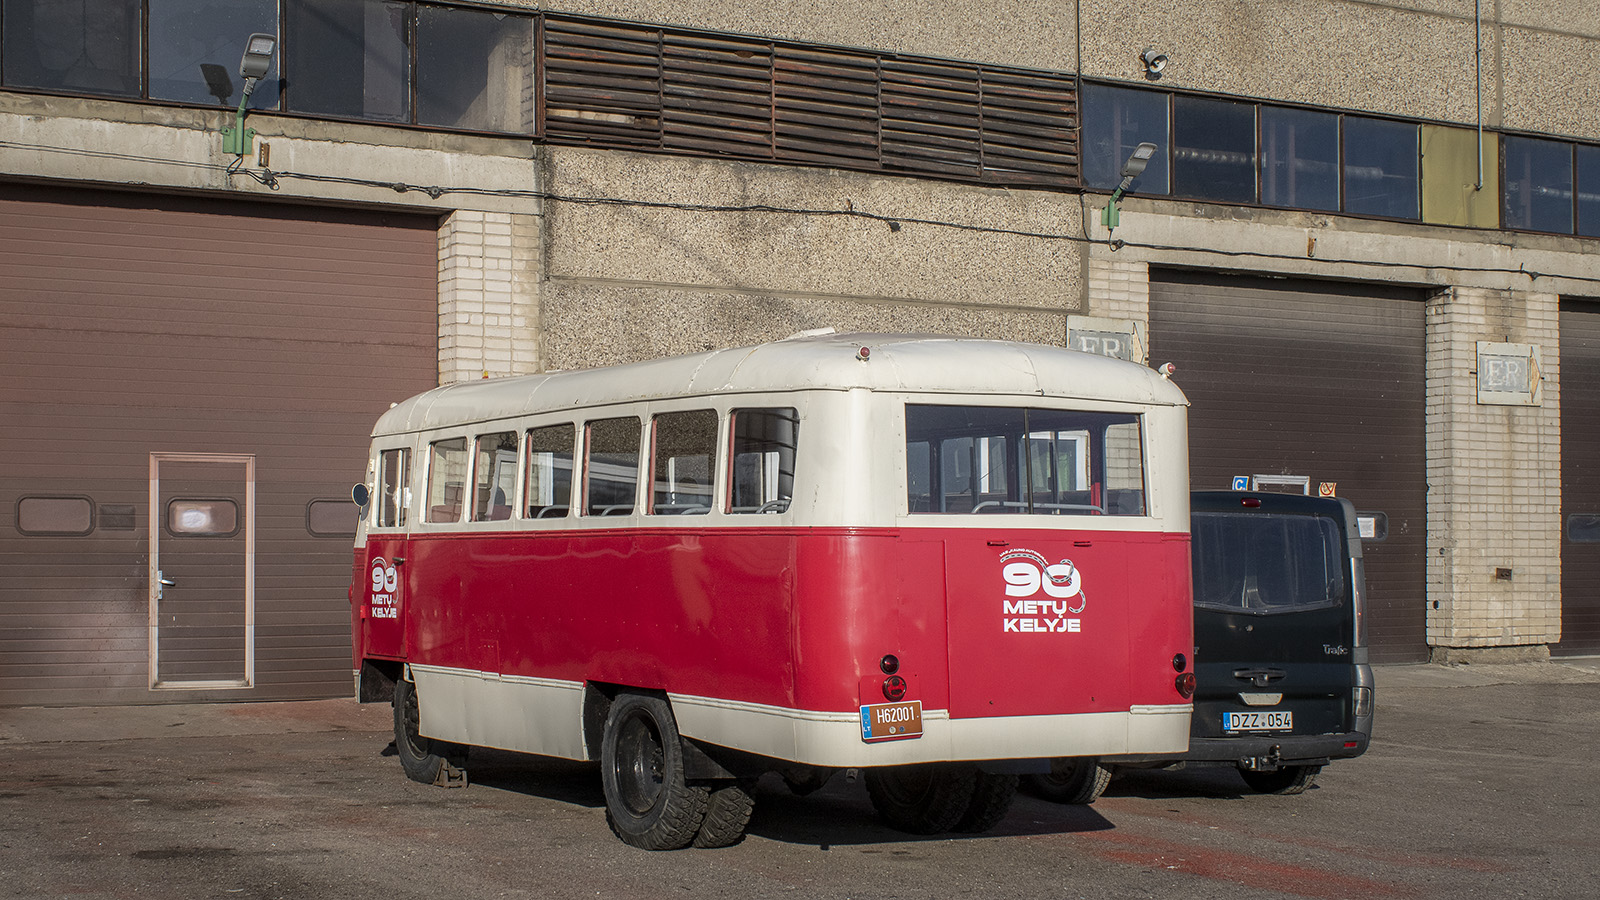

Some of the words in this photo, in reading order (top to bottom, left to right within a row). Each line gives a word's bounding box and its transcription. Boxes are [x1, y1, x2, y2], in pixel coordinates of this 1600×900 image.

[372, 566, 397, 592] 90
[1003, 562, 1081, 598] 90
[372, 607, 396, 618] KELYJE
[1003, 600, 1067, 618] METŲ
[1003, 618, 1081, 632] KELYJE
[1323, 644, 1348, 655] Trafic
[876, 706, 915, 723] H62001
[1231, 713, 1259, 728] DZZ
[1267, 713, 1291, 727] 054
